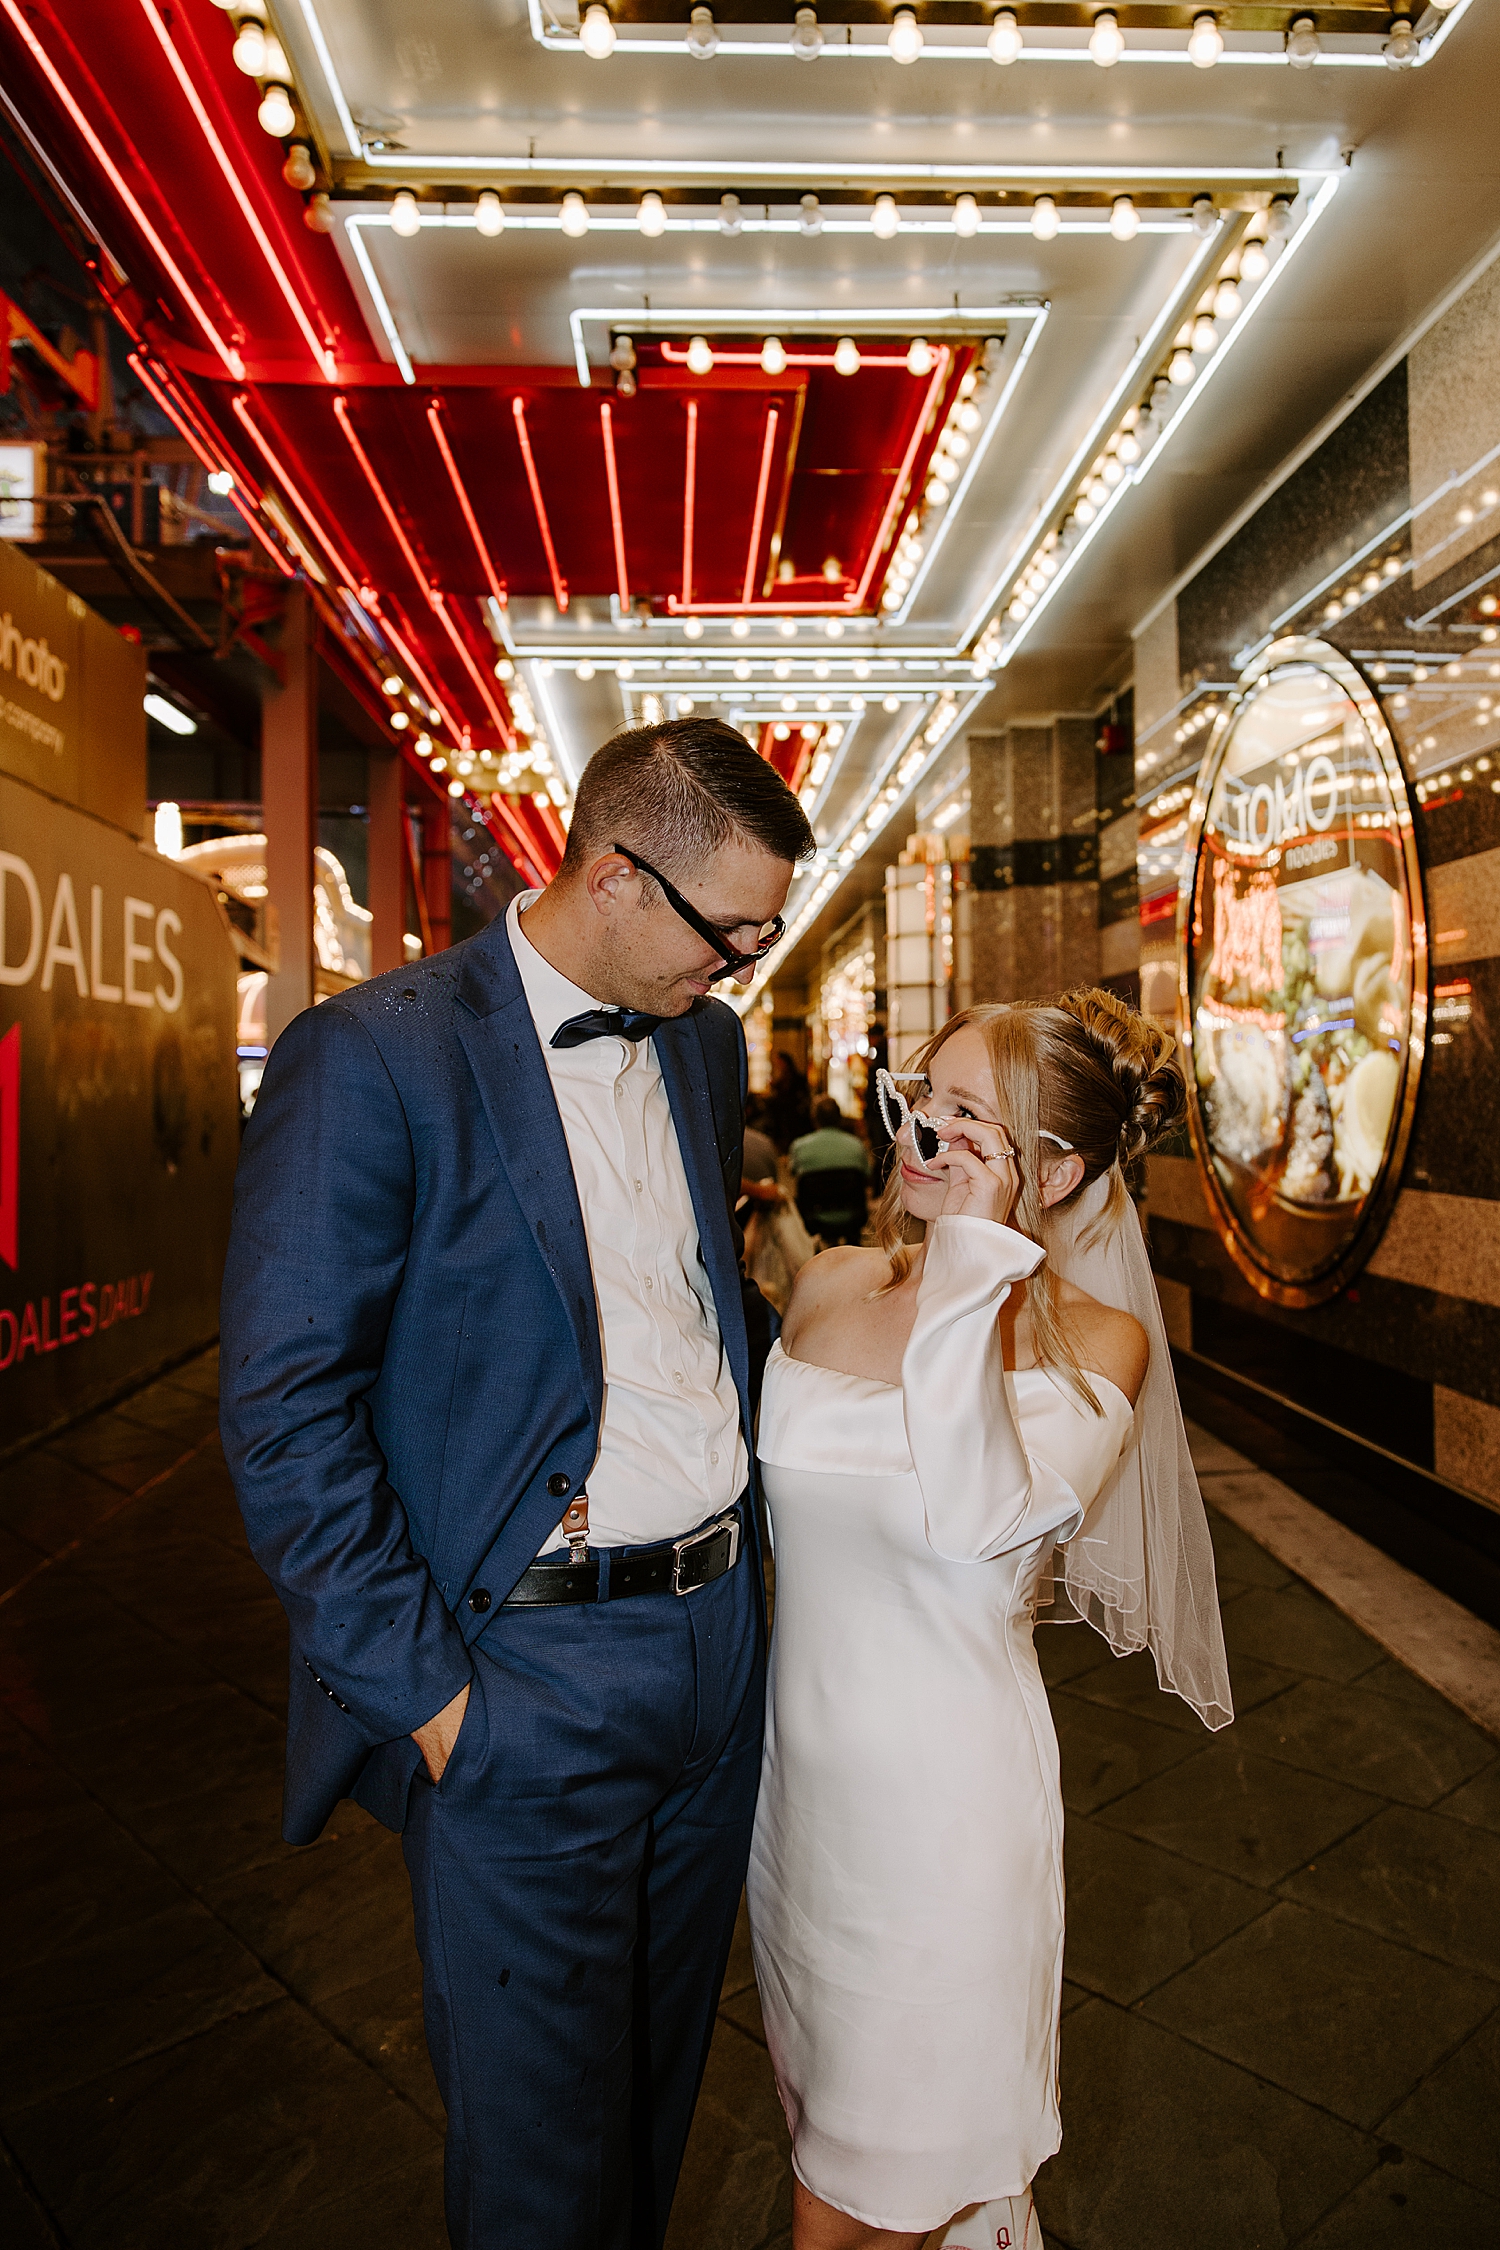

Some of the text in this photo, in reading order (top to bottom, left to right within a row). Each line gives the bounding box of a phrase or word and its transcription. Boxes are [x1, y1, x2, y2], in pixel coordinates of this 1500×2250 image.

[0, 611, 66, 701] hoto
[1232, 755, 1338, 851] TOMO
[1285, 834, 1338, 871] noodles
[0, 851, 184, 1013] DALES
[0, 1271, 154, 1371] DALES DAILY
